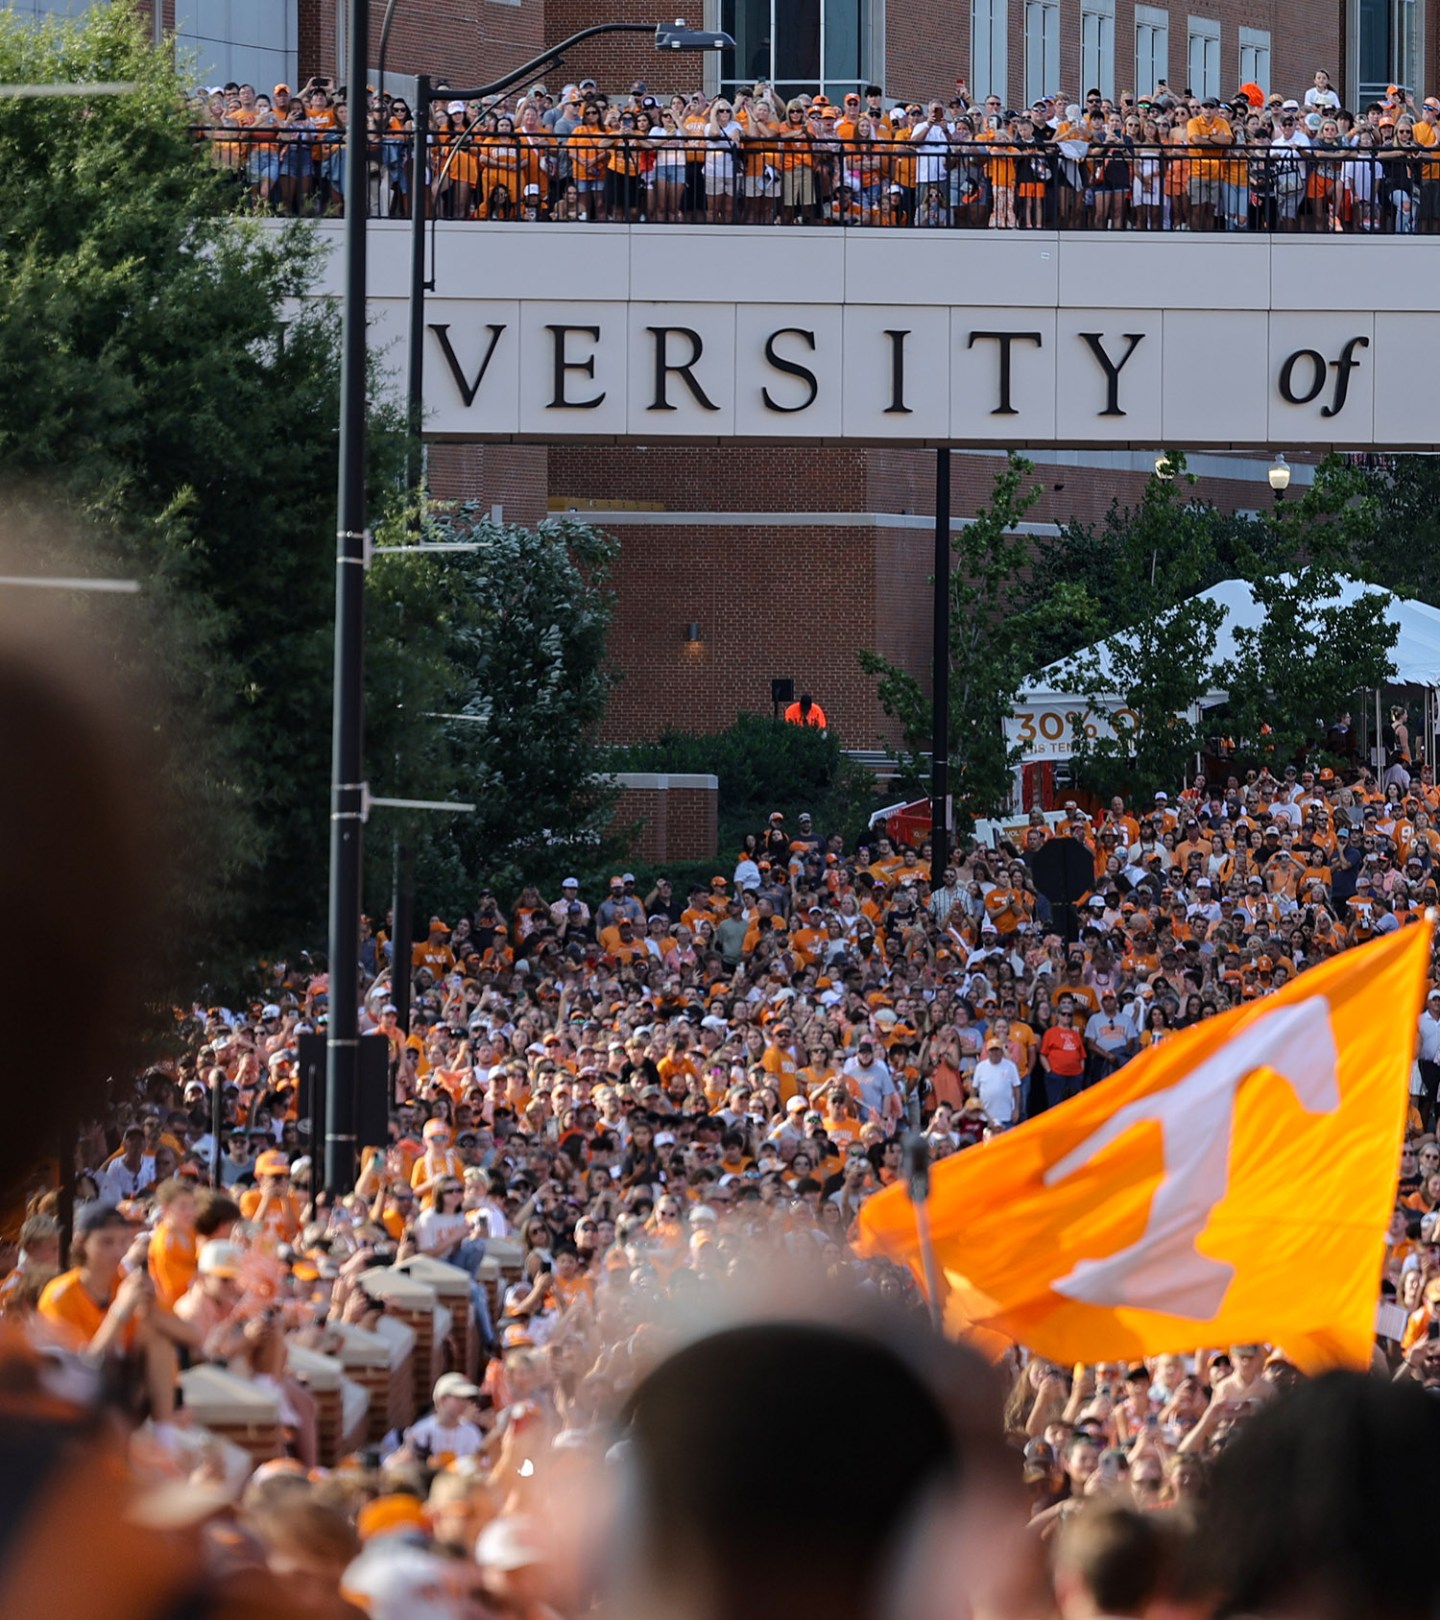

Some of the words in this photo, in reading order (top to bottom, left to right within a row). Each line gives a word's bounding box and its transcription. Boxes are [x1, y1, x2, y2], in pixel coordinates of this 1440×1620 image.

[347, 323, 1146, 417] VERSITY
[1279, 336, 1370, 418] of
[1013, 709, 1098, 741] 30%
[1042, 993, 1341, 1322] T
